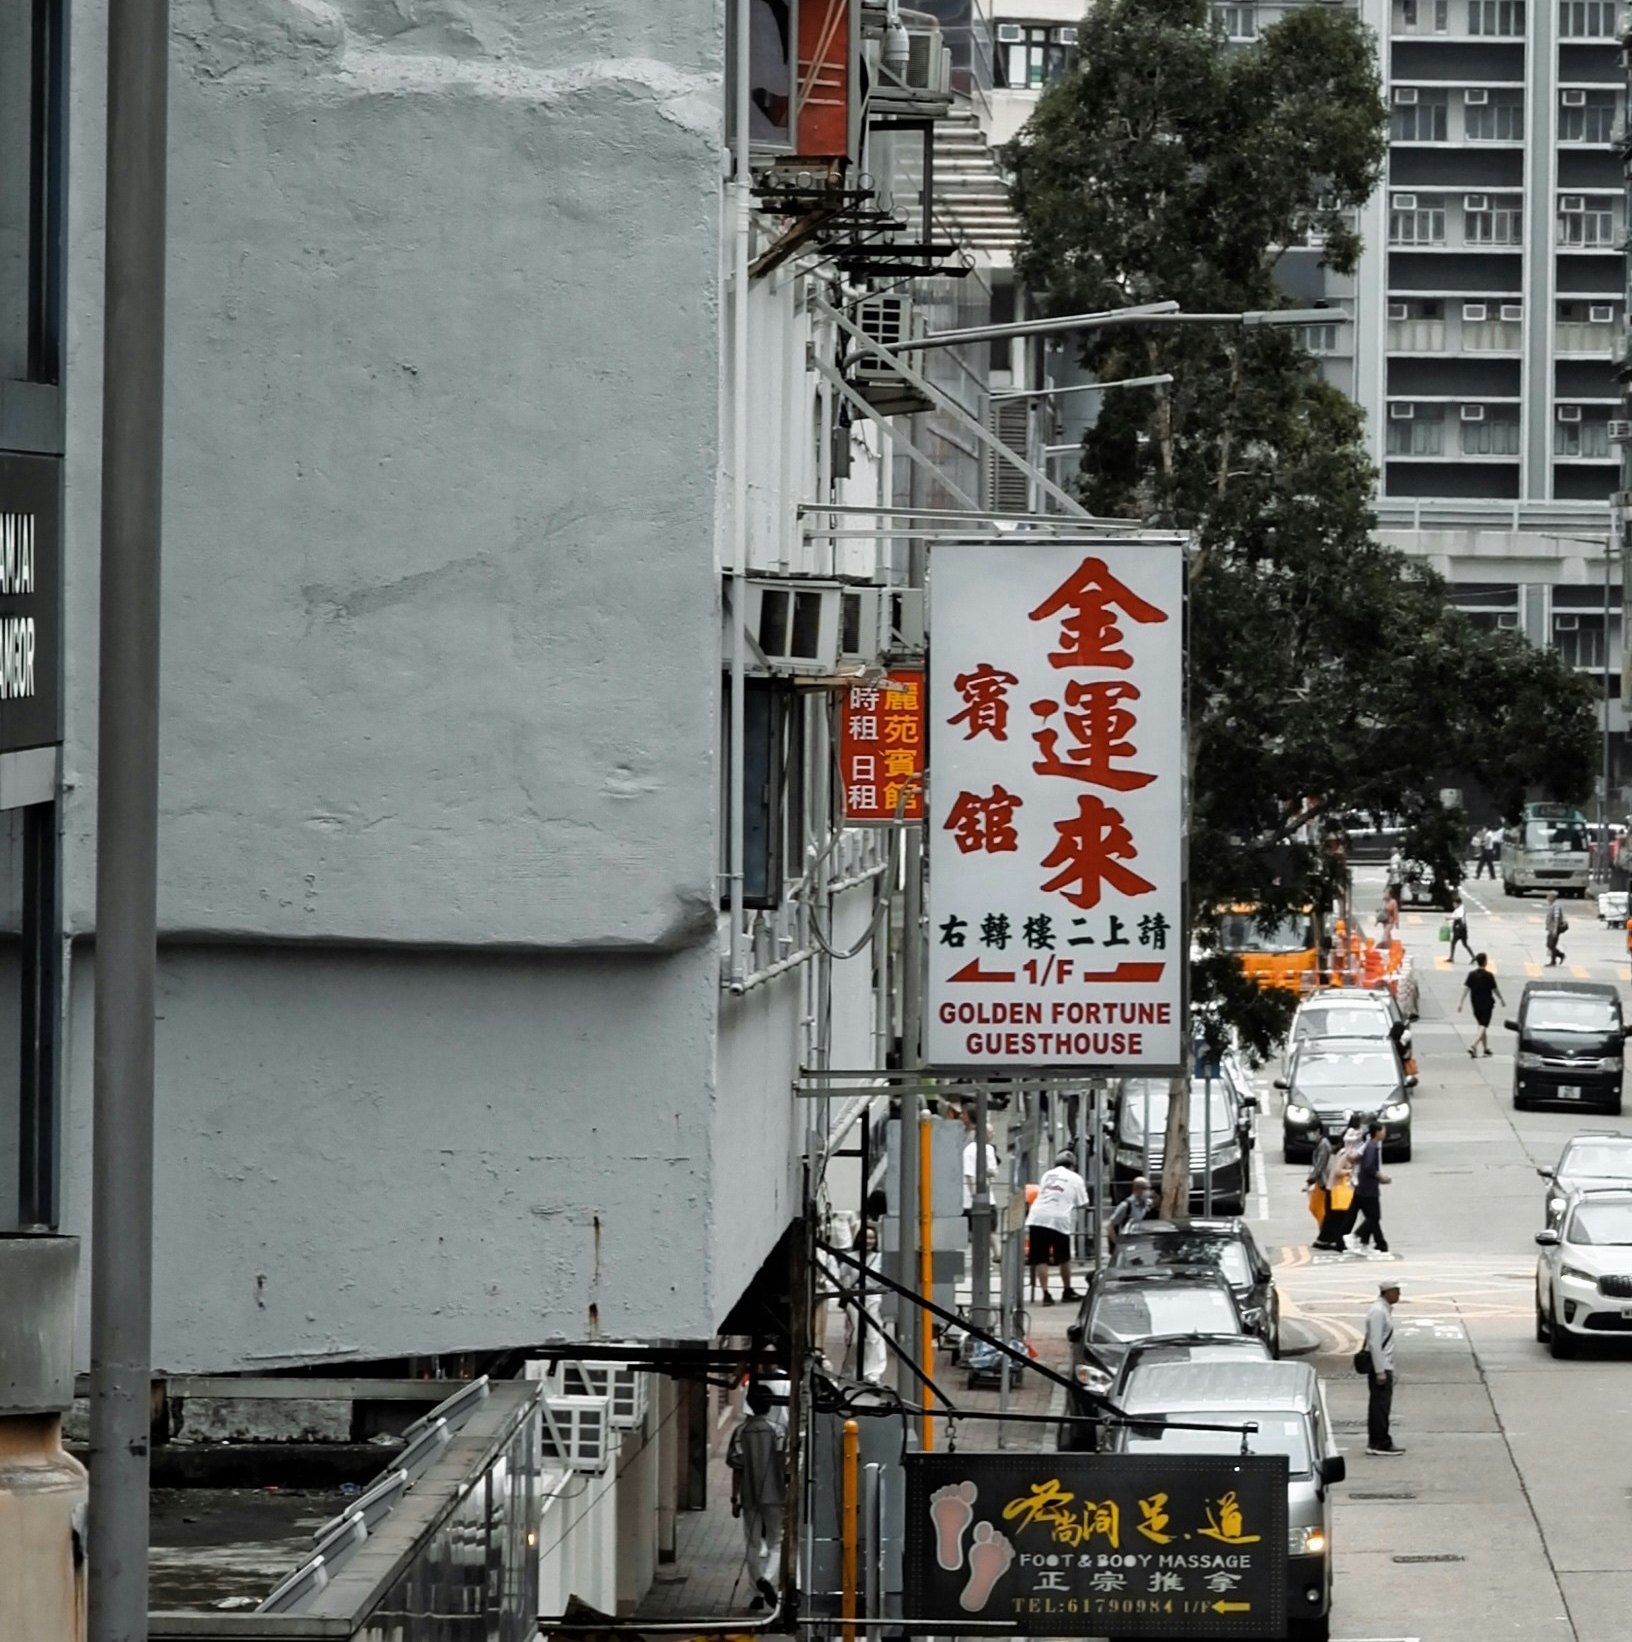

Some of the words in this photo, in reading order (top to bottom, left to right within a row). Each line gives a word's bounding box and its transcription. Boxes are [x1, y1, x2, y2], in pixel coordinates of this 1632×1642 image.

[848, 686, 879, 741] 時租
[1028, 557, 1168, 909] 金運來
[848, 756, 879, 810] 日租
[1022, 954, 1074, 986] 1/F
[939, 1003, 1042, 1024] GOLDEN
[1052, 1003, 1171, 1024] FORTUNE
[966, 1033, 1143, 1055] GUESTHOUSE
[1158, 1554, 1251, 1568] MASSAGE
[1033, 1571, 1242, 1593] 正宗推拿
